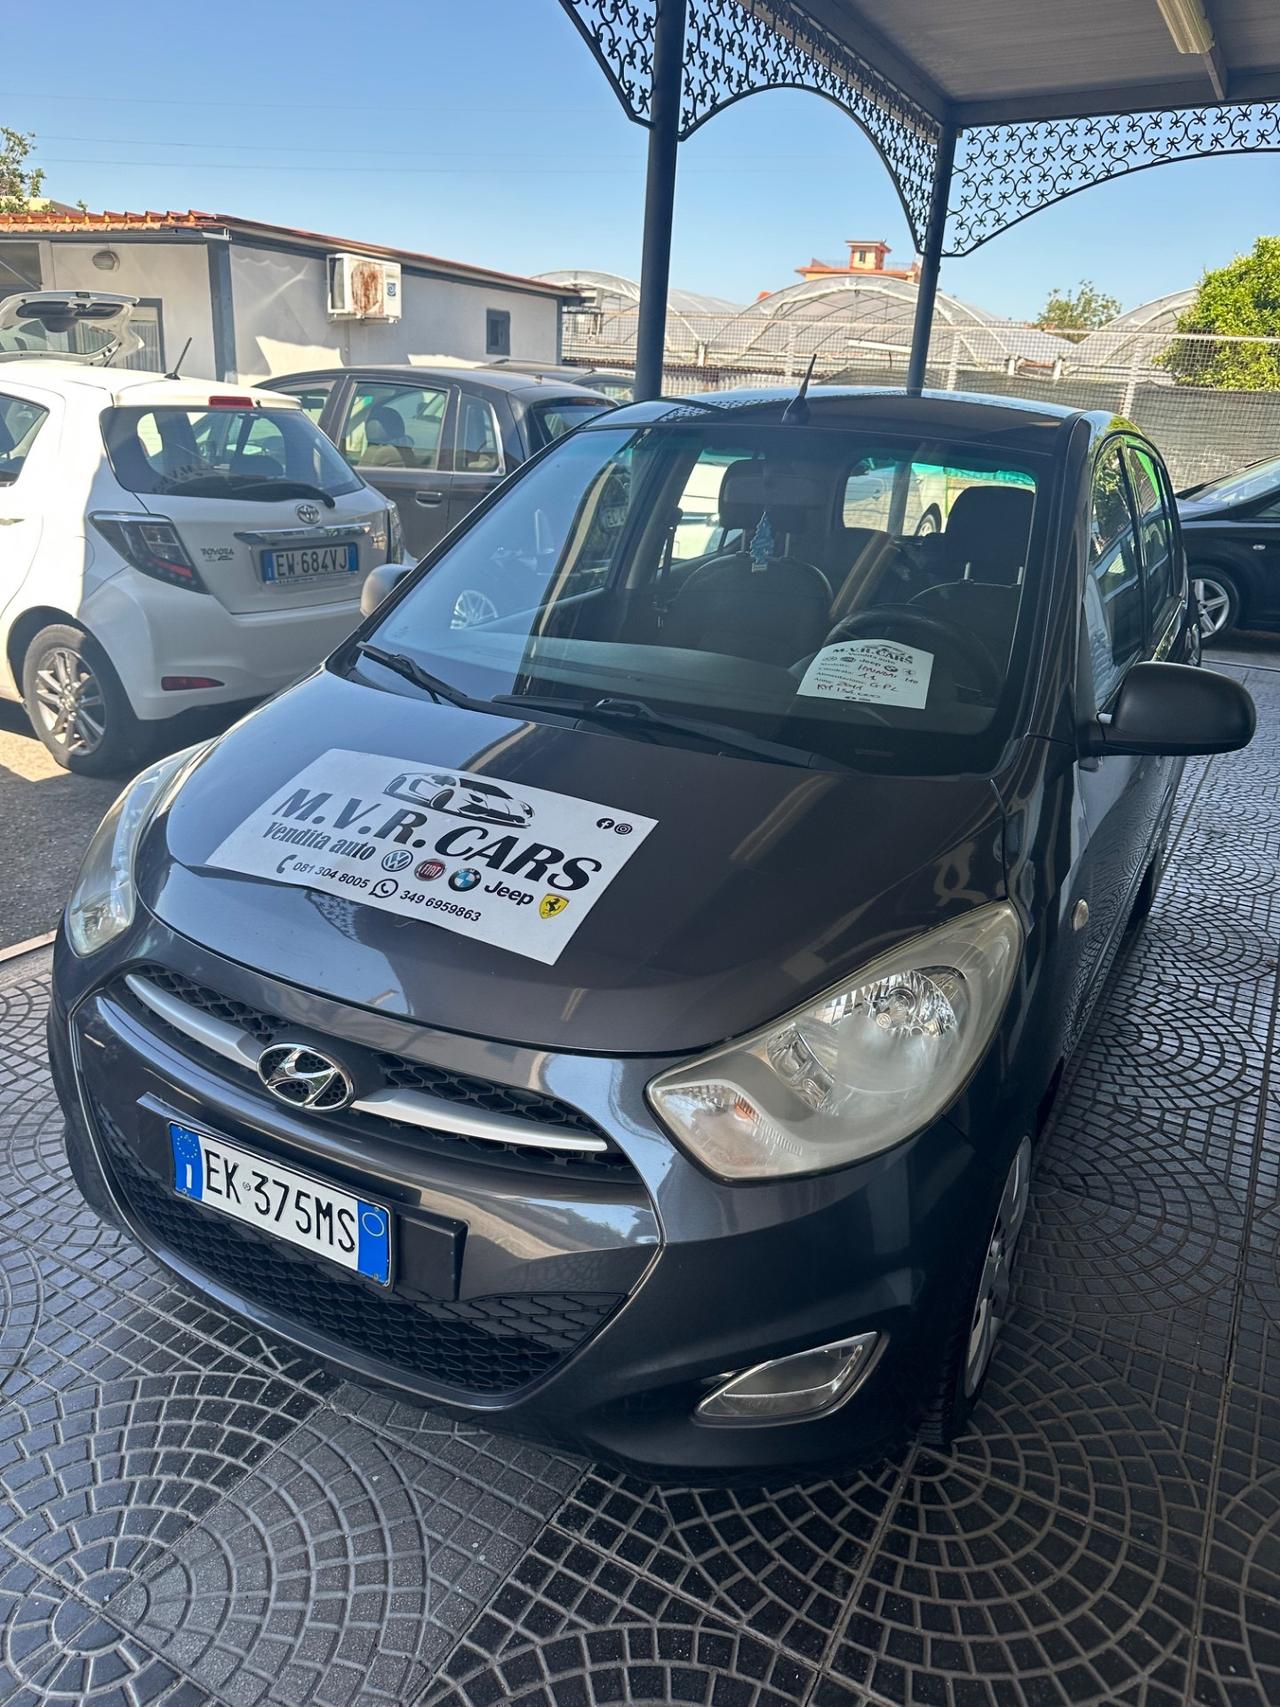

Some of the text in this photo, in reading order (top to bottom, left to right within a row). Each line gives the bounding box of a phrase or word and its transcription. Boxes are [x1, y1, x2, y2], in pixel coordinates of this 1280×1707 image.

[262, 821, 377, 862] Vendita auto
[292, 861, 371, 889] 081 304 8005
[400, 889, 482, 922] 349 6959863
[484, 881, 535, 906] Jeep
